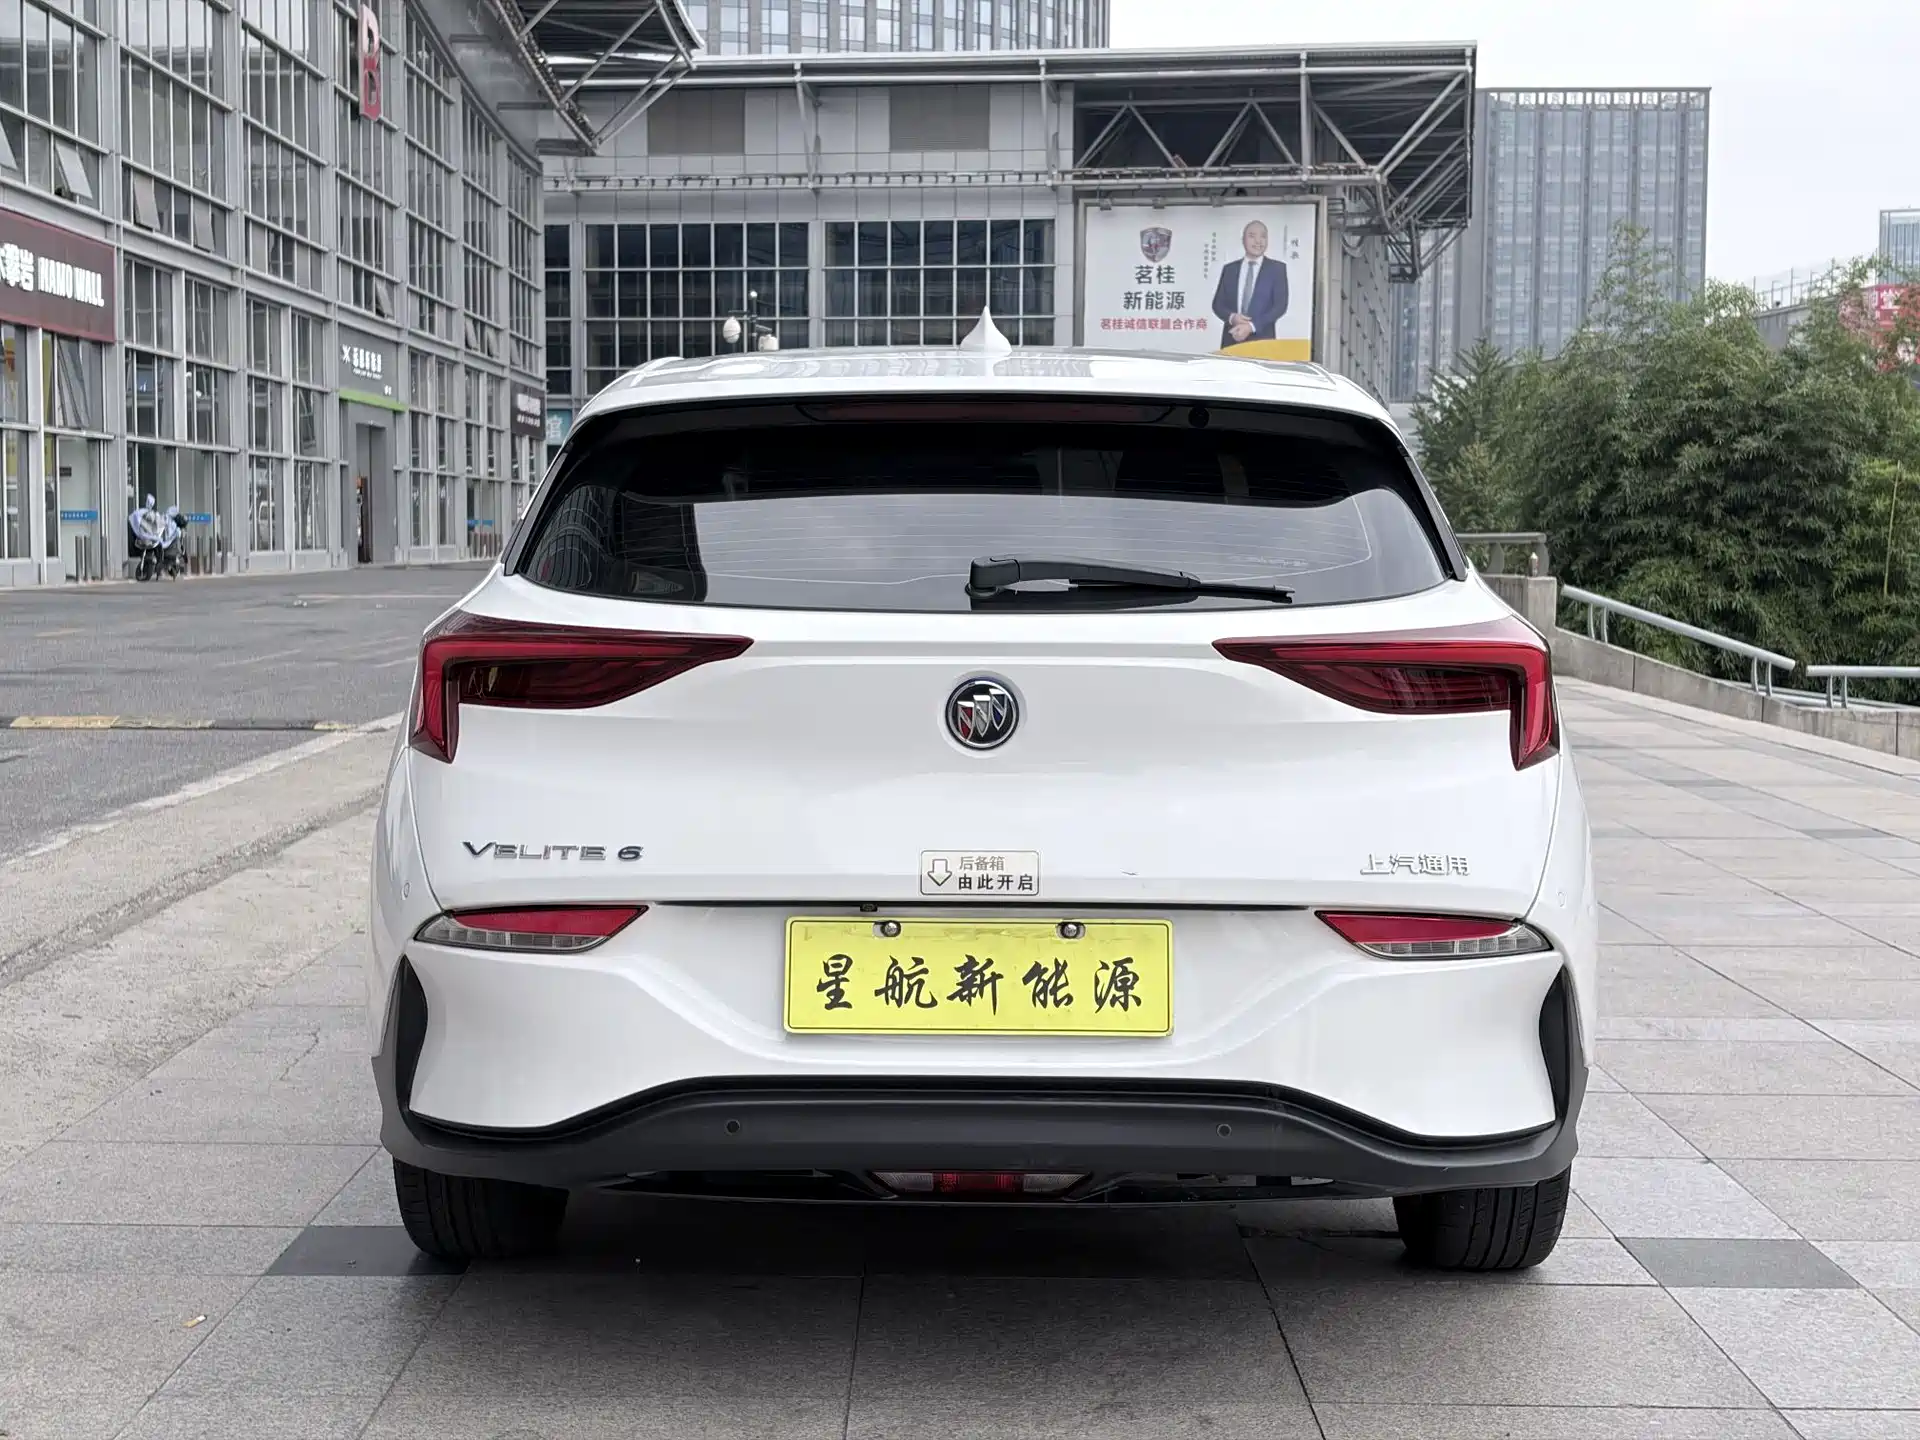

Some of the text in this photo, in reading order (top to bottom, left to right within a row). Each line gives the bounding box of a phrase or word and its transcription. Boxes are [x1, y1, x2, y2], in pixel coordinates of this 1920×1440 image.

[1134, 265, 1175, 285] 茗桂
[1122, 291, 1185, 310] 新能源
[1100, 318, 1208, 331] 茗桂诚信联盟合作商
[462, 841, 644, 860] VELITE 6
[958, 856, 1005, 871] 后备箱
[1360, 852, 1470, 876] 上汽通用
[958, 873, 1034, 892] 由此开启
[816, 953, 1142, 1015] 星航新能源
